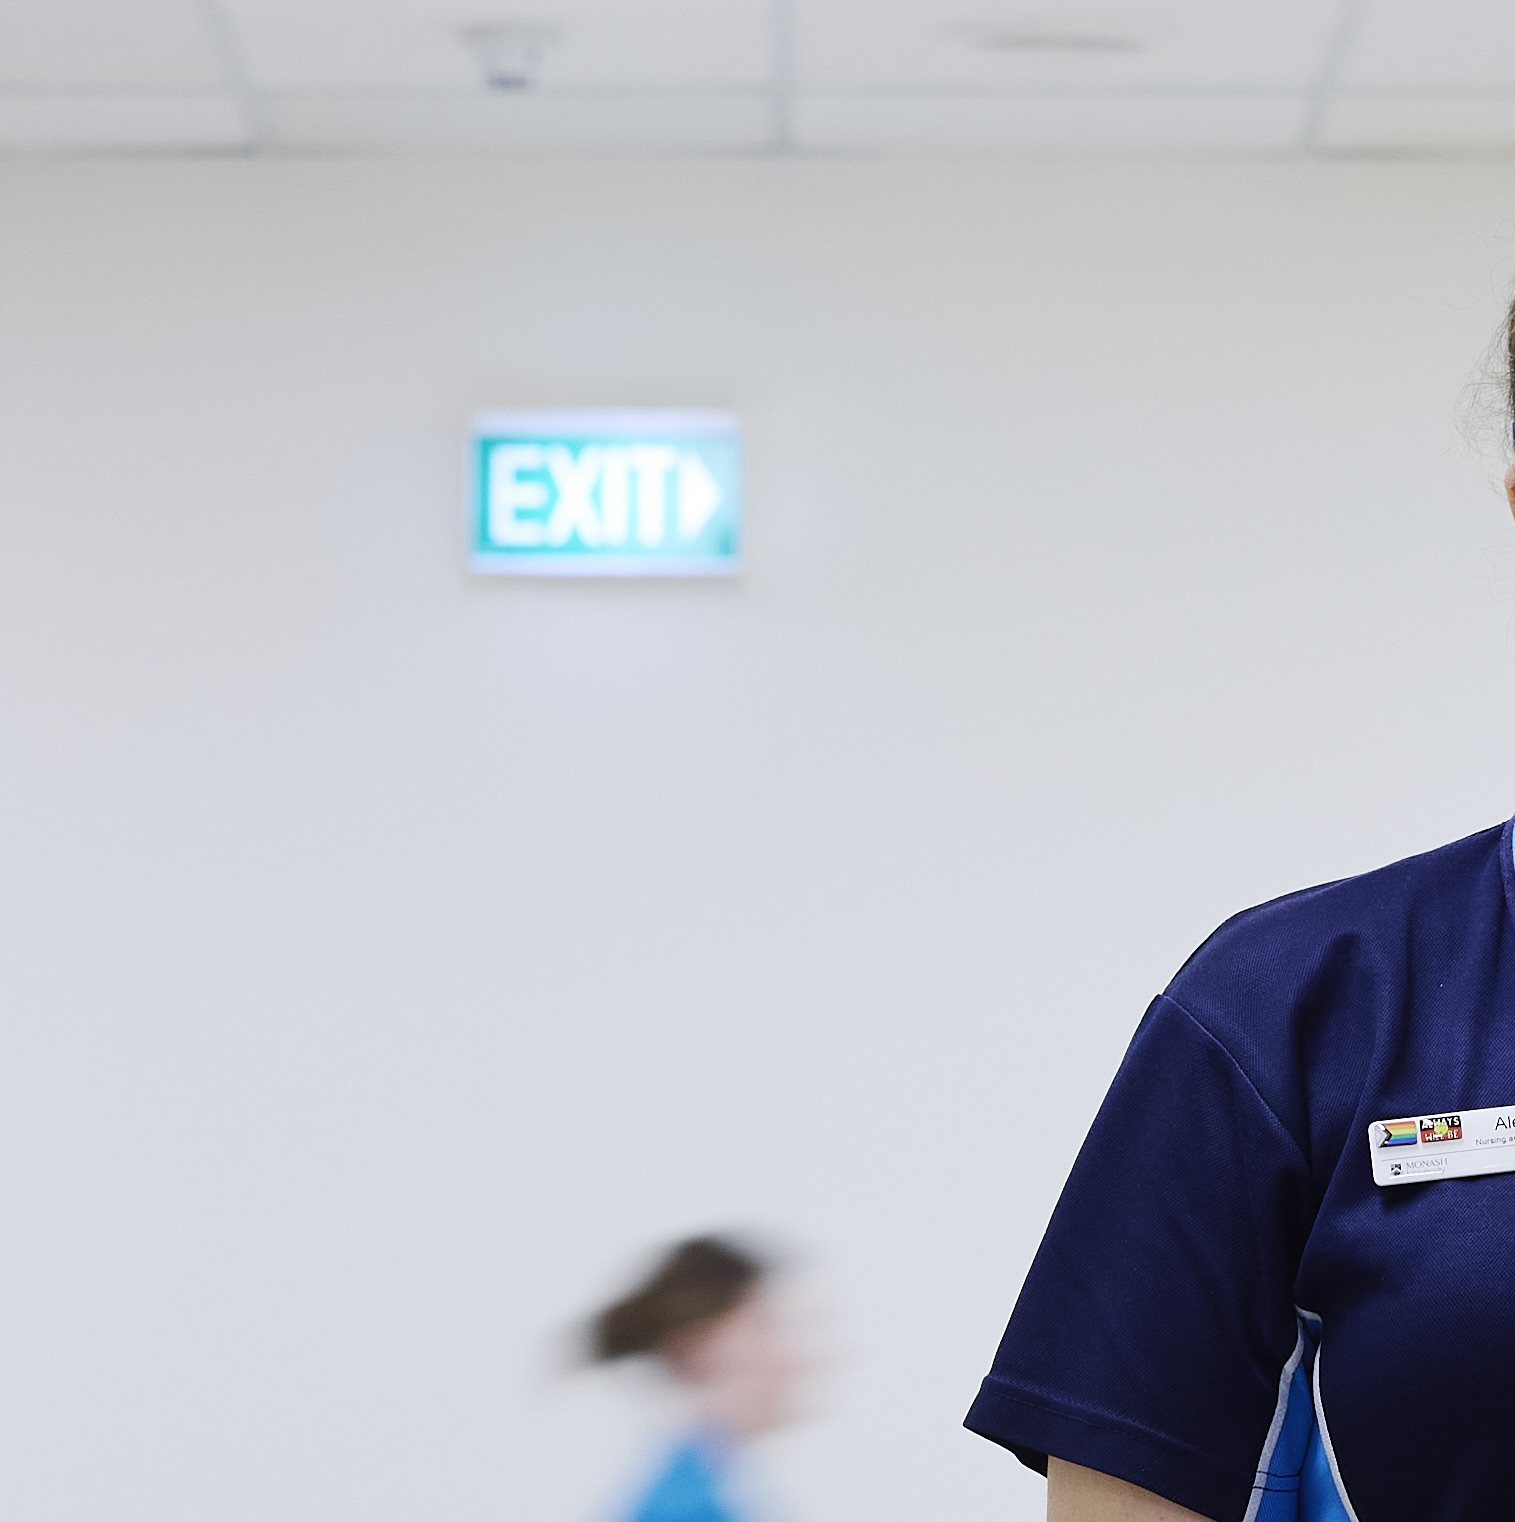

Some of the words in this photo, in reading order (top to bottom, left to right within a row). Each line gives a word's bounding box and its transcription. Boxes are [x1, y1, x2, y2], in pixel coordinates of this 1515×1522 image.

[489, 443, 677, 548] EXIT
[1447, 1129, 1459, 1139] BE
[1475, 1136, 1507, 1145] Nursing
[1406, 1157, 1448, 1169] MONASH
